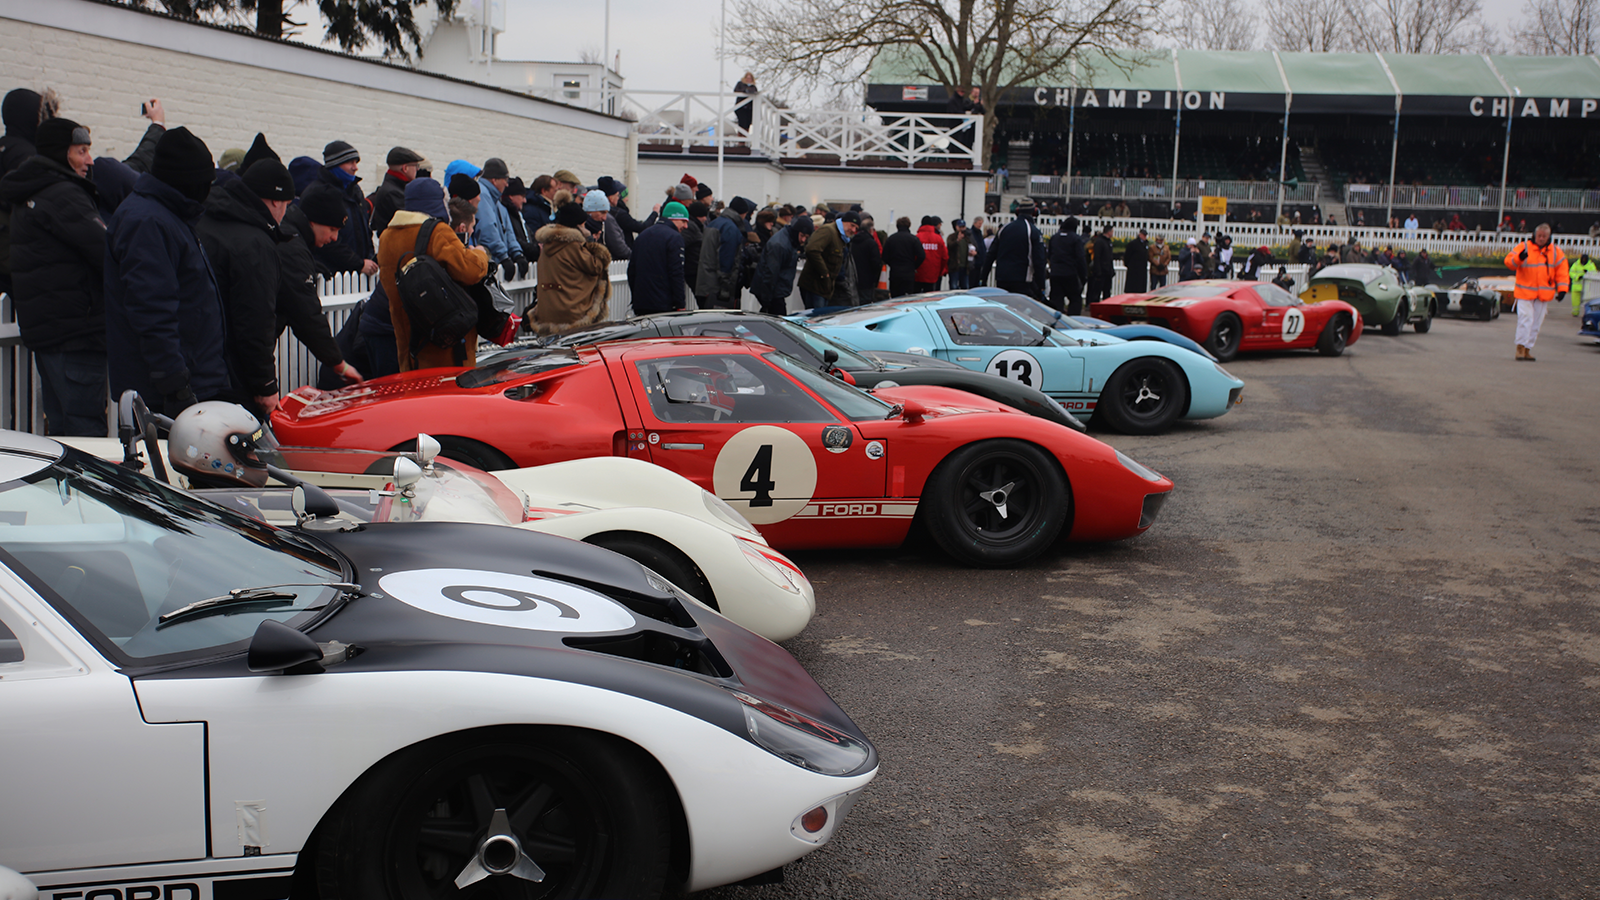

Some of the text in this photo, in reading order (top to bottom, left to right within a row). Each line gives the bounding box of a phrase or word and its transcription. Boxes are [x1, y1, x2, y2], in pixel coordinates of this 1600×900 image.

[1034, 87, 1225, 110] CHAMPION
[1286, 315, 1300, 335] 27
[995, 359, 1032, 387] 13
[1057, 401, 1085, 410] ORD
[740, 444, 776, 508] 4
[822, 504, 878, 516] FORD
